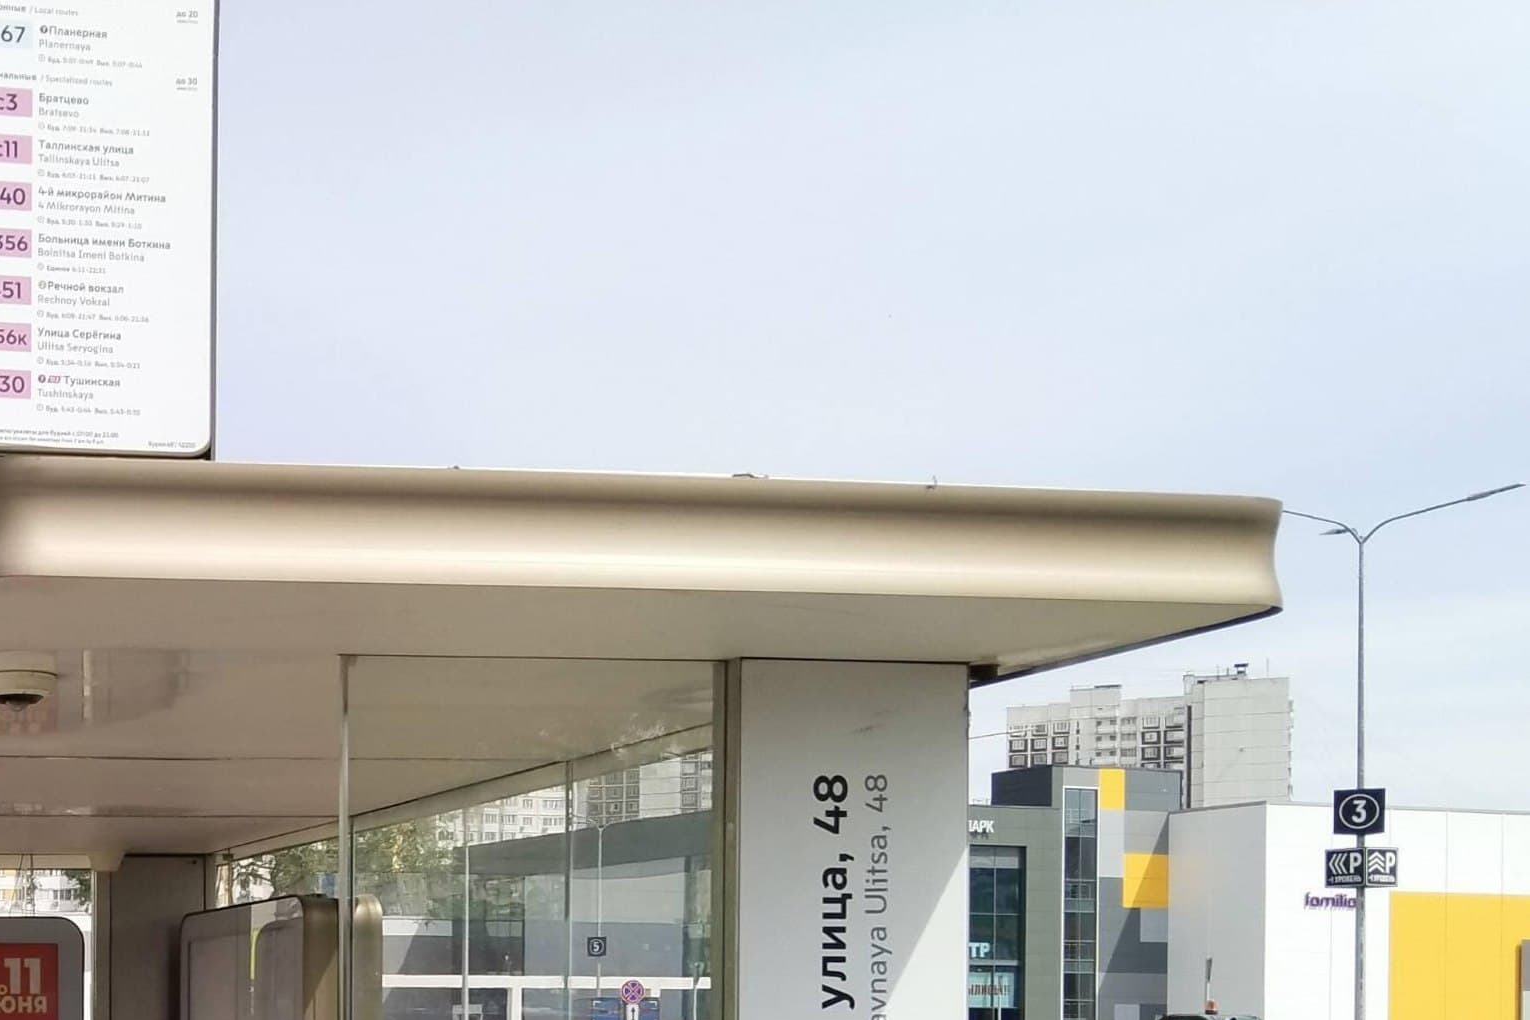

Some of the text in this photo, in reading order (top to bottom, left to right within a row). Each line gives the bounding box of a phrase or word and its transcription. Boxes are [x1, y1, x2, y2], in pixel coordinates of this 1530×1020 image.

[50, 26, 107, 39] Планерная
[39, 40, 90, 51] Planernaya
[39, 94, 89, 106] Братцево
[39, 108, 79, 118] Bratsevo
[39, 140, 133, 155] Таллинская улица
[39, 155, 119, 167] Tallinskaya Ulitsa
[38, 187, 166, 203] 4-й микрорайон Митина
[46, 201, 101, 214] Mikrorayon
[104, 205, 135, 215] Mitina
[38, 234, 170, 250] Больница имени Боткина
[38, 248, 144, 262] Bolnitsa Imeni Botkina
[48, 281, 124, 294] Речной вокзал
[38, 294, 110, 306] Rechnoy Vokzal
[38, 327, 121, 341] Улица Серёгина
[38, 342, 113, 355] Ulitsa Seryogina
[65, 376, 120, 388] Тушинская
[38, 388, 93, 400] Tushinskaya
[864, 774, 888, 812] 48
[813, 774, 848, 835] 48
[1352, 800, 1366, 823] 3
[863, 824, 893, 914] Ulitsa,
[1349, 852, 1362, 873] P
[1386, 852, 1395, 873] P
[820, 851, 855, 1011] улица,
[593, 942, 599, 952] 5
[4, 957, 42, 995] 11
